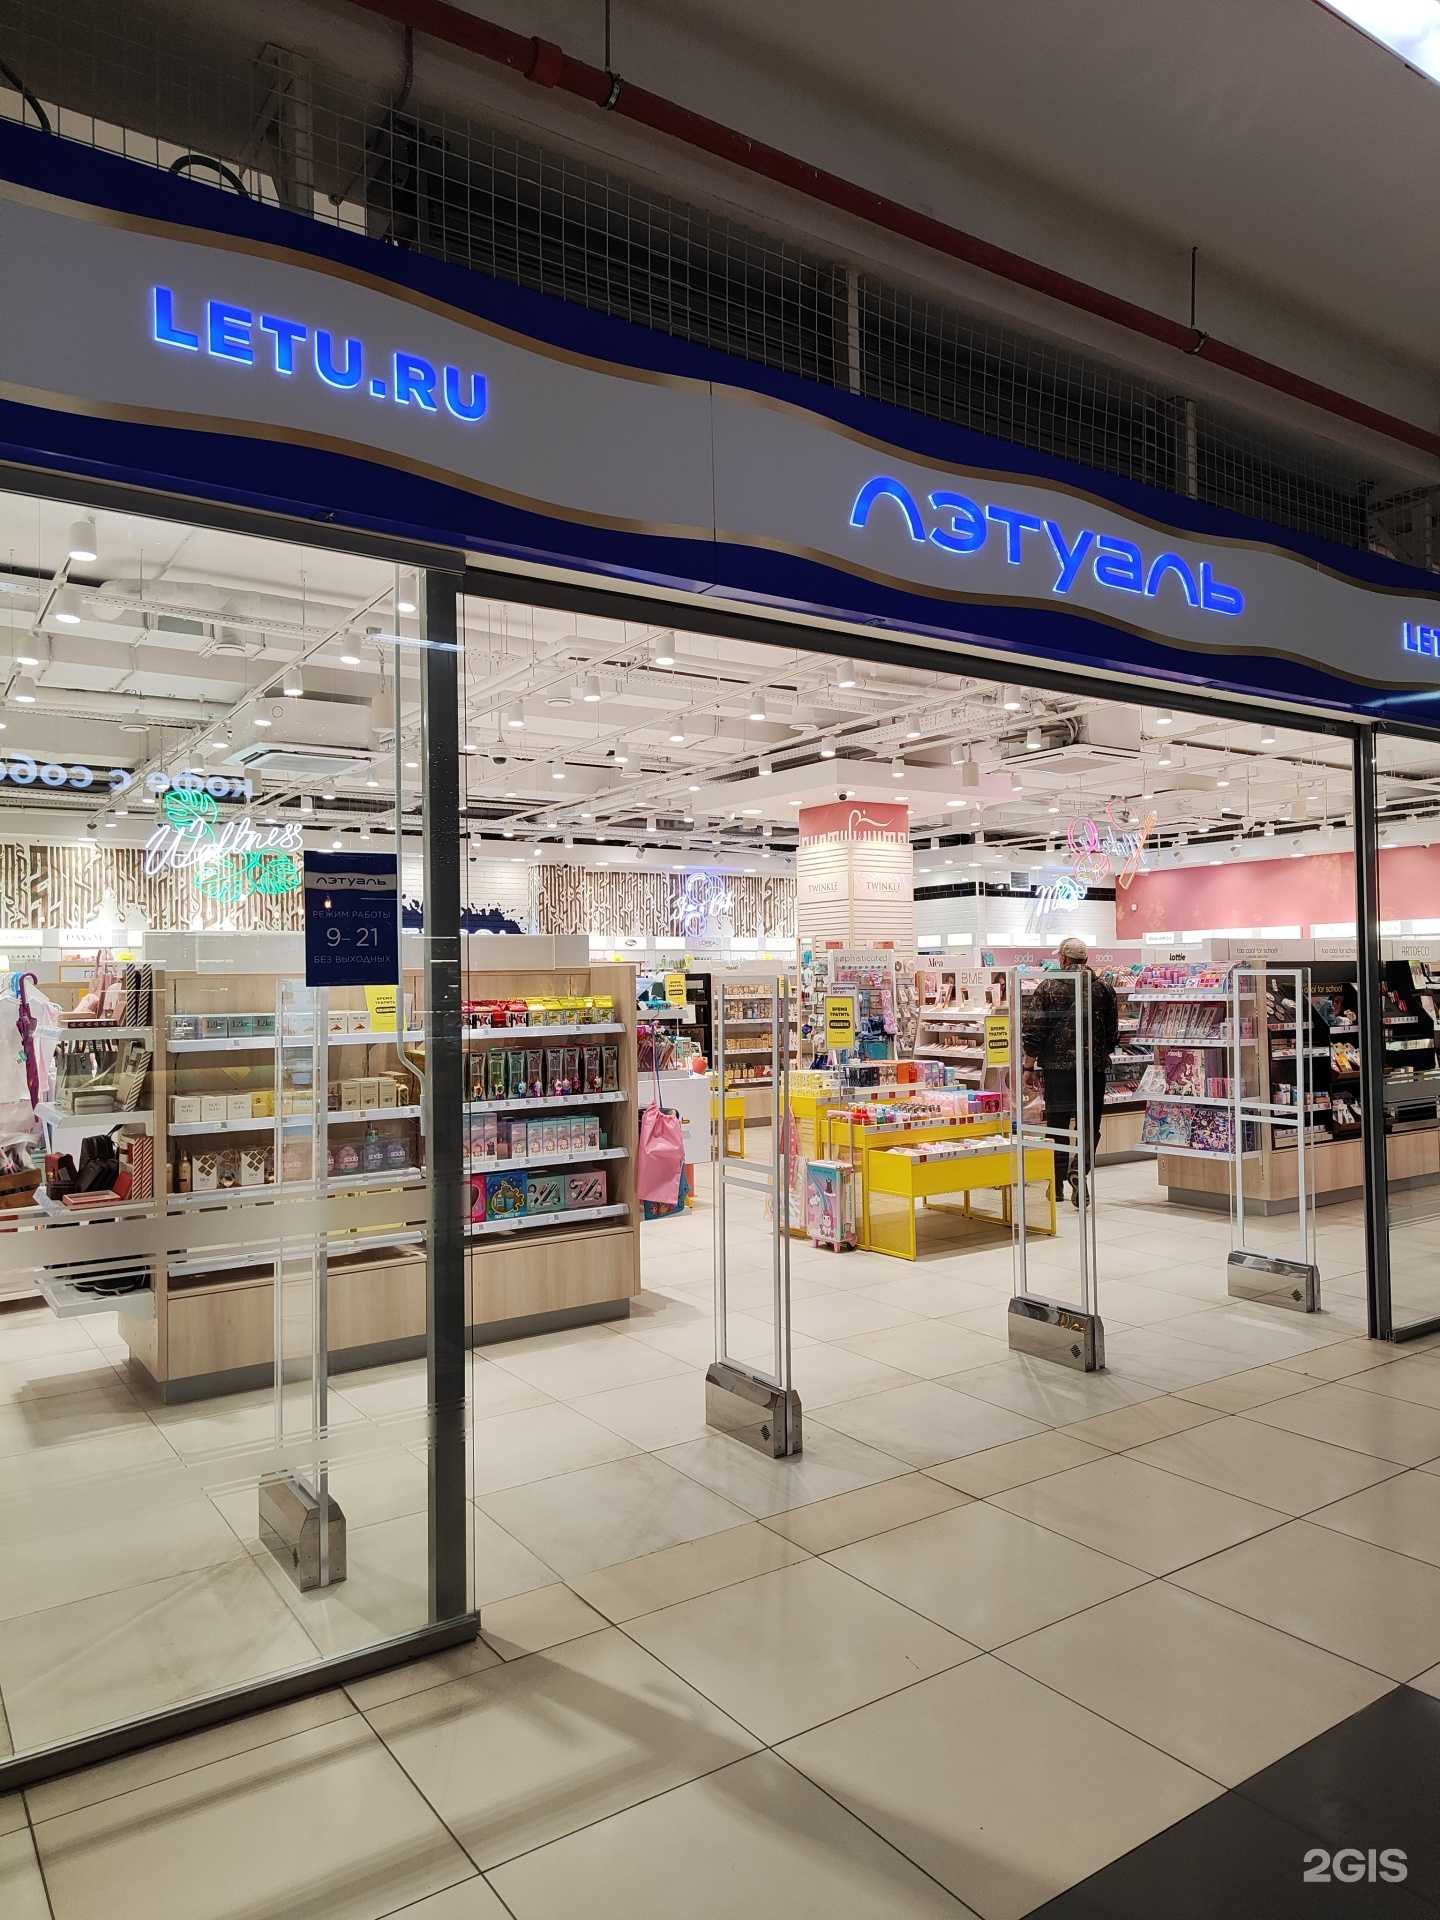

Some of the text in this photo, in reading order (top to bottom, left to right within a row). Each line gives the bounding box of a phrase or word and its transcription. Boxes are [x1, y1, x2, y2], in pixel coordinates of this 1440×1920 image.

[153, 286, 488, 422] LETU.RU
[312, 910, 391, 919] РЕЖИМ РАБОТЫ
[314, 955, 391, 964] БЕЗ ВЫХОДНЫХ
